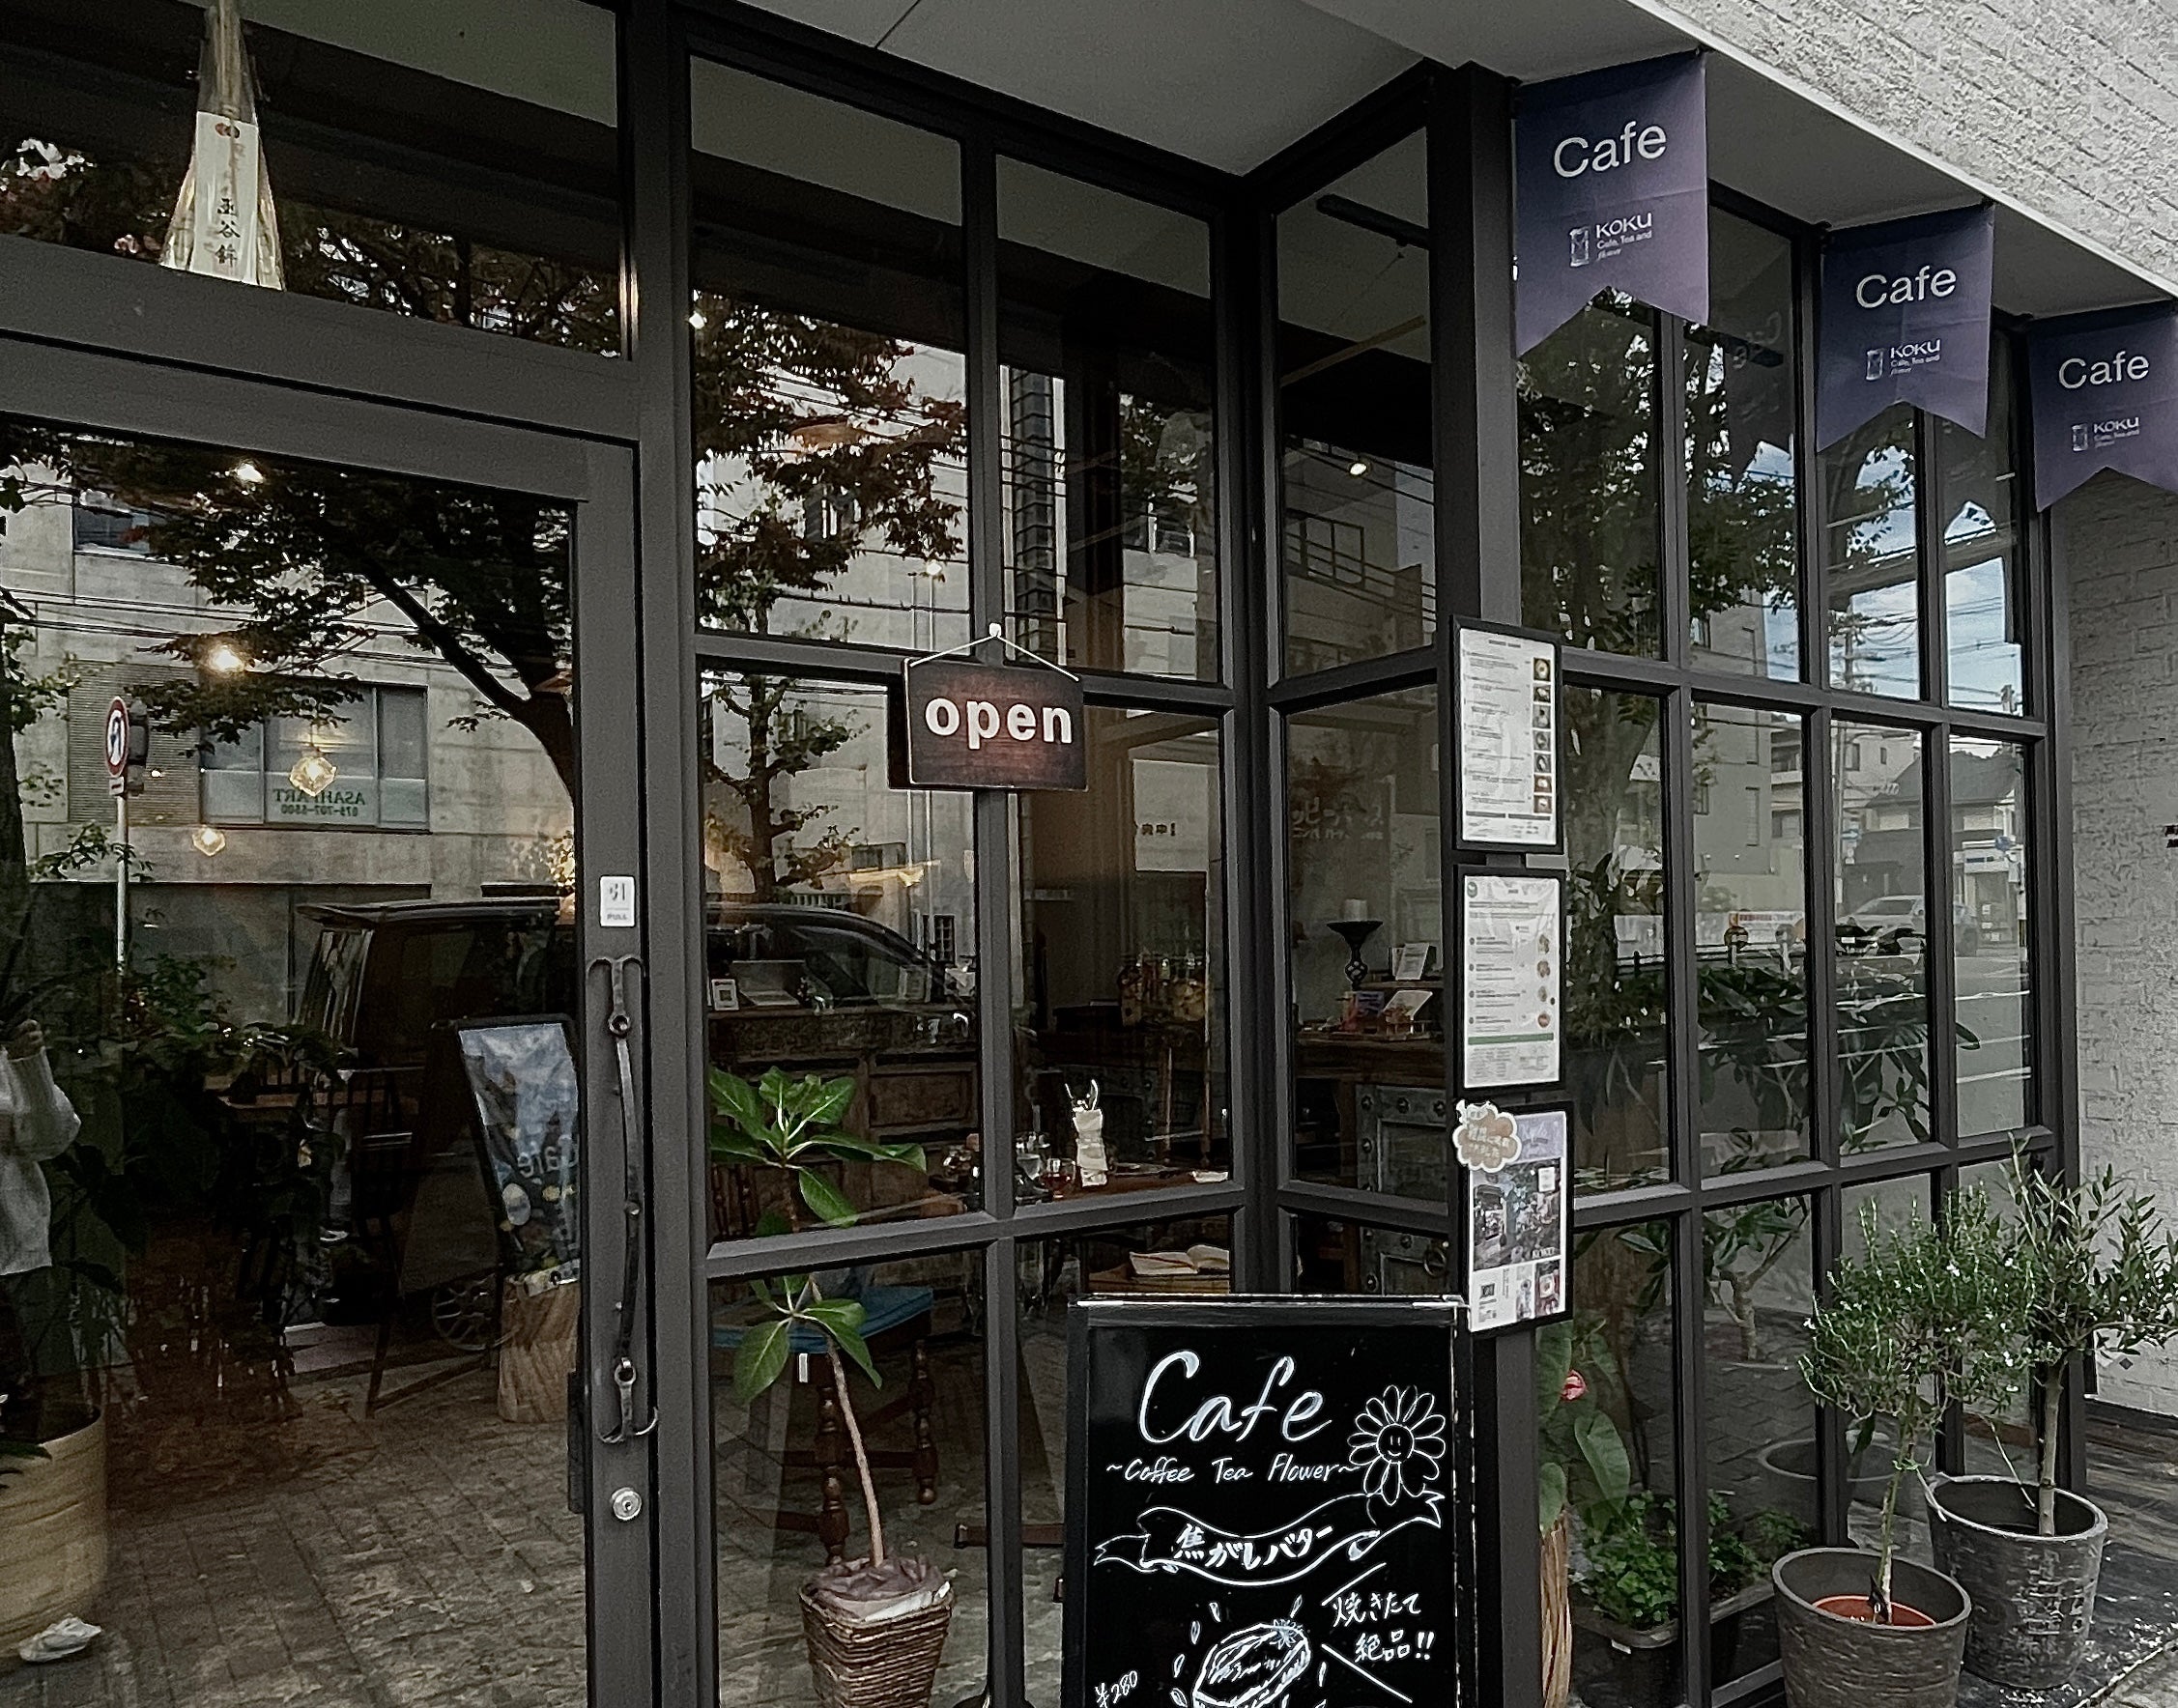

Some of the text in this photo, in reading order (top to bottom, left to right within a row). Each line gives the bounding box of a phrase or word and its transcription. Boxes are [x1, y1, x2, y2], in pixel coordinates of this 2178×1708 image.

[1554, 121, 1667, 178] Cafe
[1595, 213, 1652, 238] KOKU
[1856, 265, 1957, 308] Cafe
[1890, 339, 1941, 358] KOKU
[2058, 351, 2150, 389] Cafe
[2094, 416, 2139, 434] KOKU
[925, 697, 1073, 750] open
[1139, 1350, 1333, 1443] Cafe
[1212, 1457, 1254, 1484] Tea
[1173, 1523, 1333, 1571] 焦がしバター
[1333, 1591, 1421, 1628] 焼きたて
